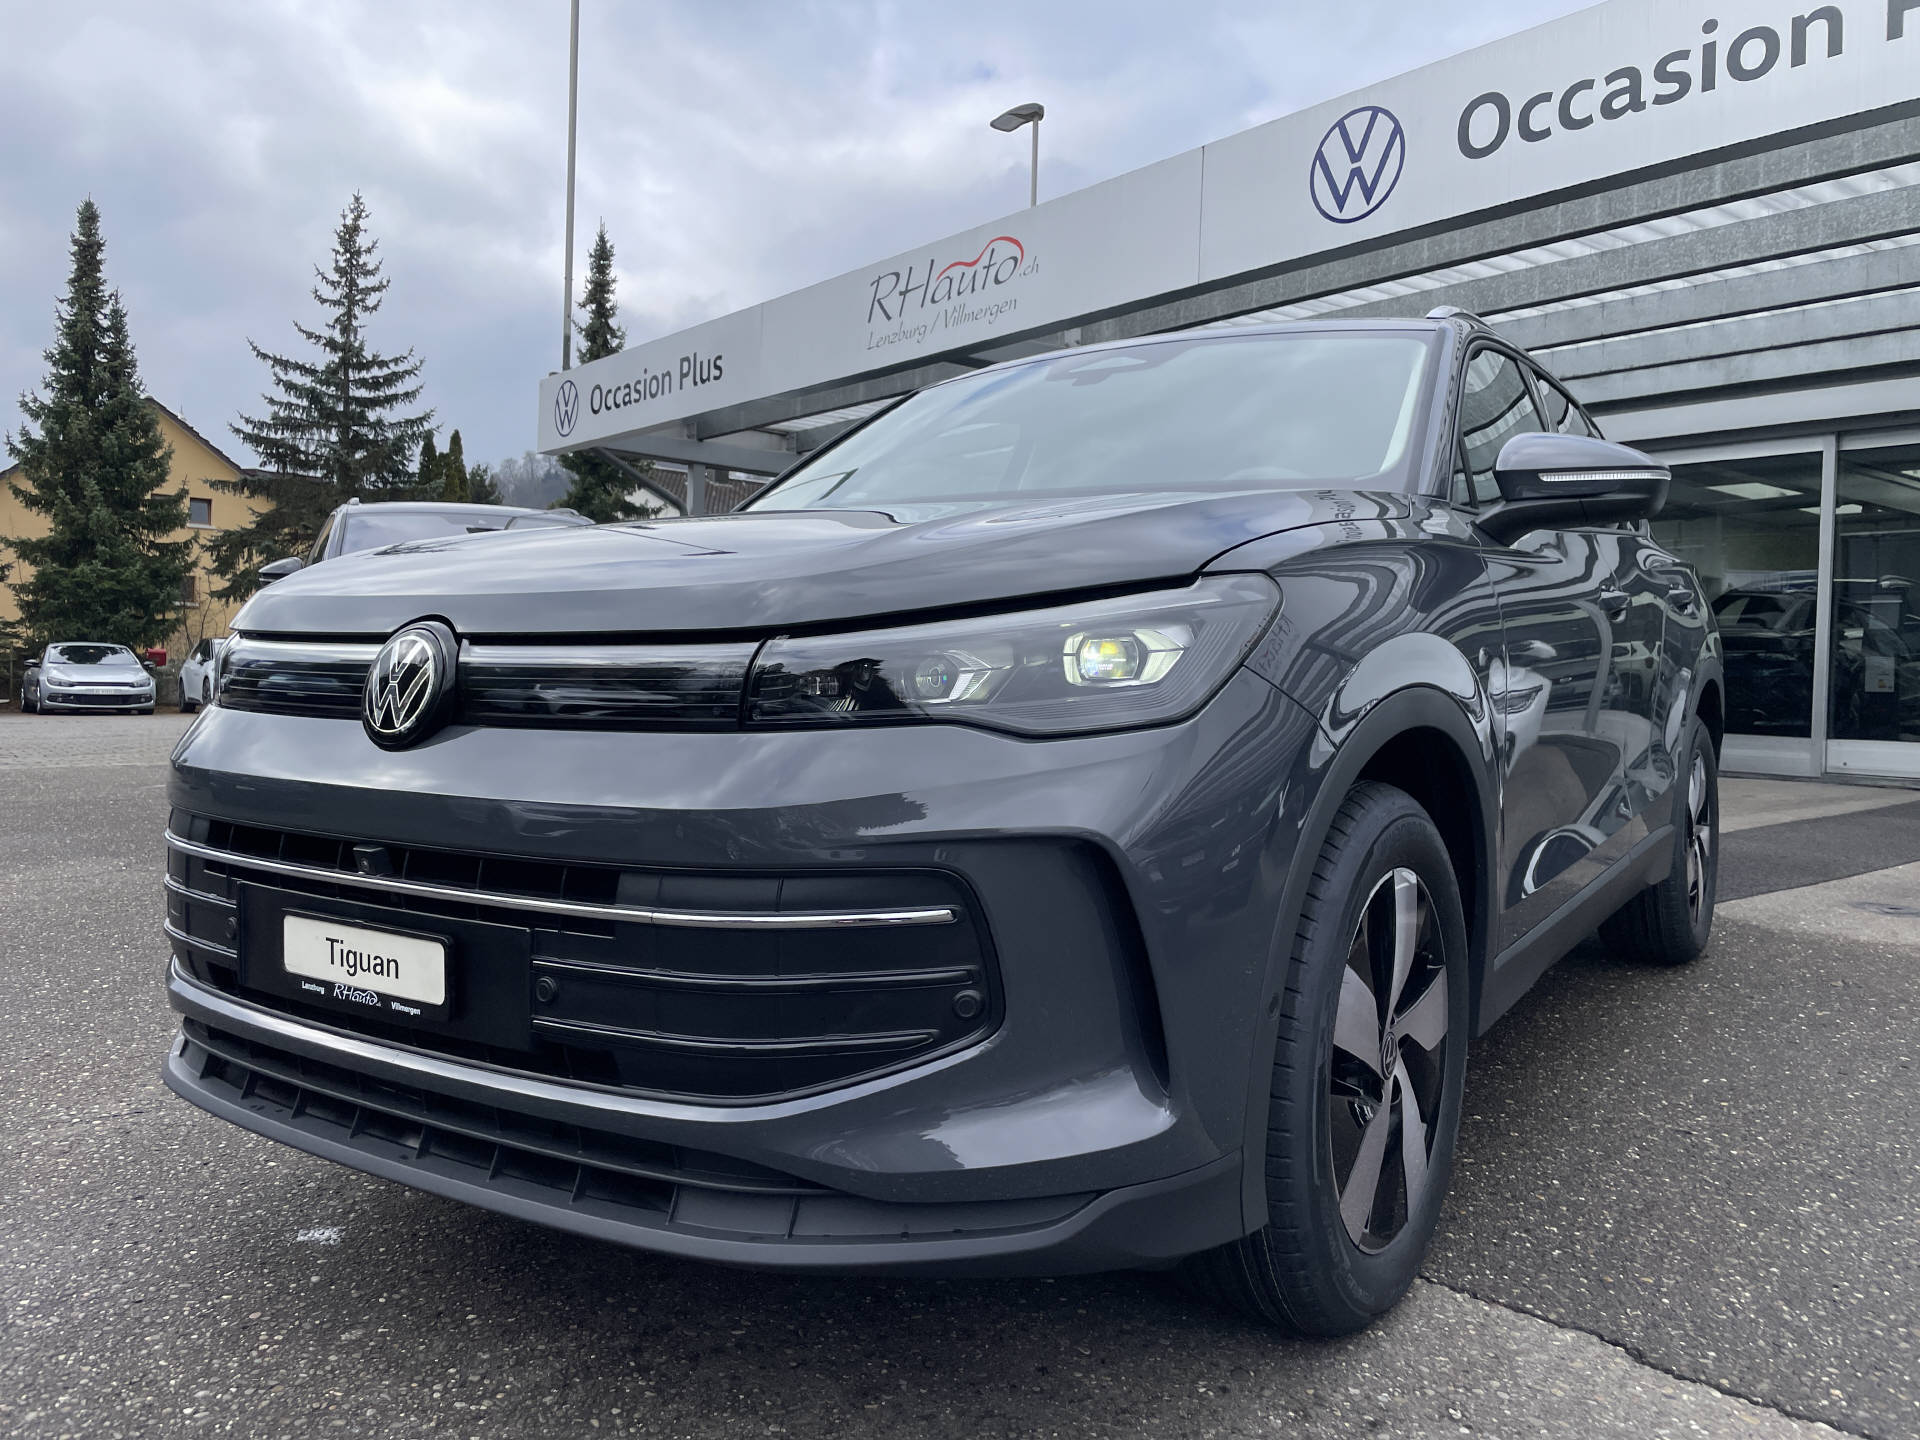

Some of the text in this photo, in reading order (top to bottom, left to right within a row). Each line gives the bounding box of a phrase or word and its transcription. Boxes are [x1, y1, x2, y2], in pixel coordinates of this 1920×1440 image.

[1456, 4, 1844, 160] Occasion
[866, 321, 928, 350] Lenzburg
[944, 298, 1017, 329] Villmergen
[590, 352, 723, 415] Occasion Plus
[325, 936, 399, 980] Tiguan
[301, 980, 325, 995] Lenzburg
[391, 1001, 421, 1016] Villmergen
